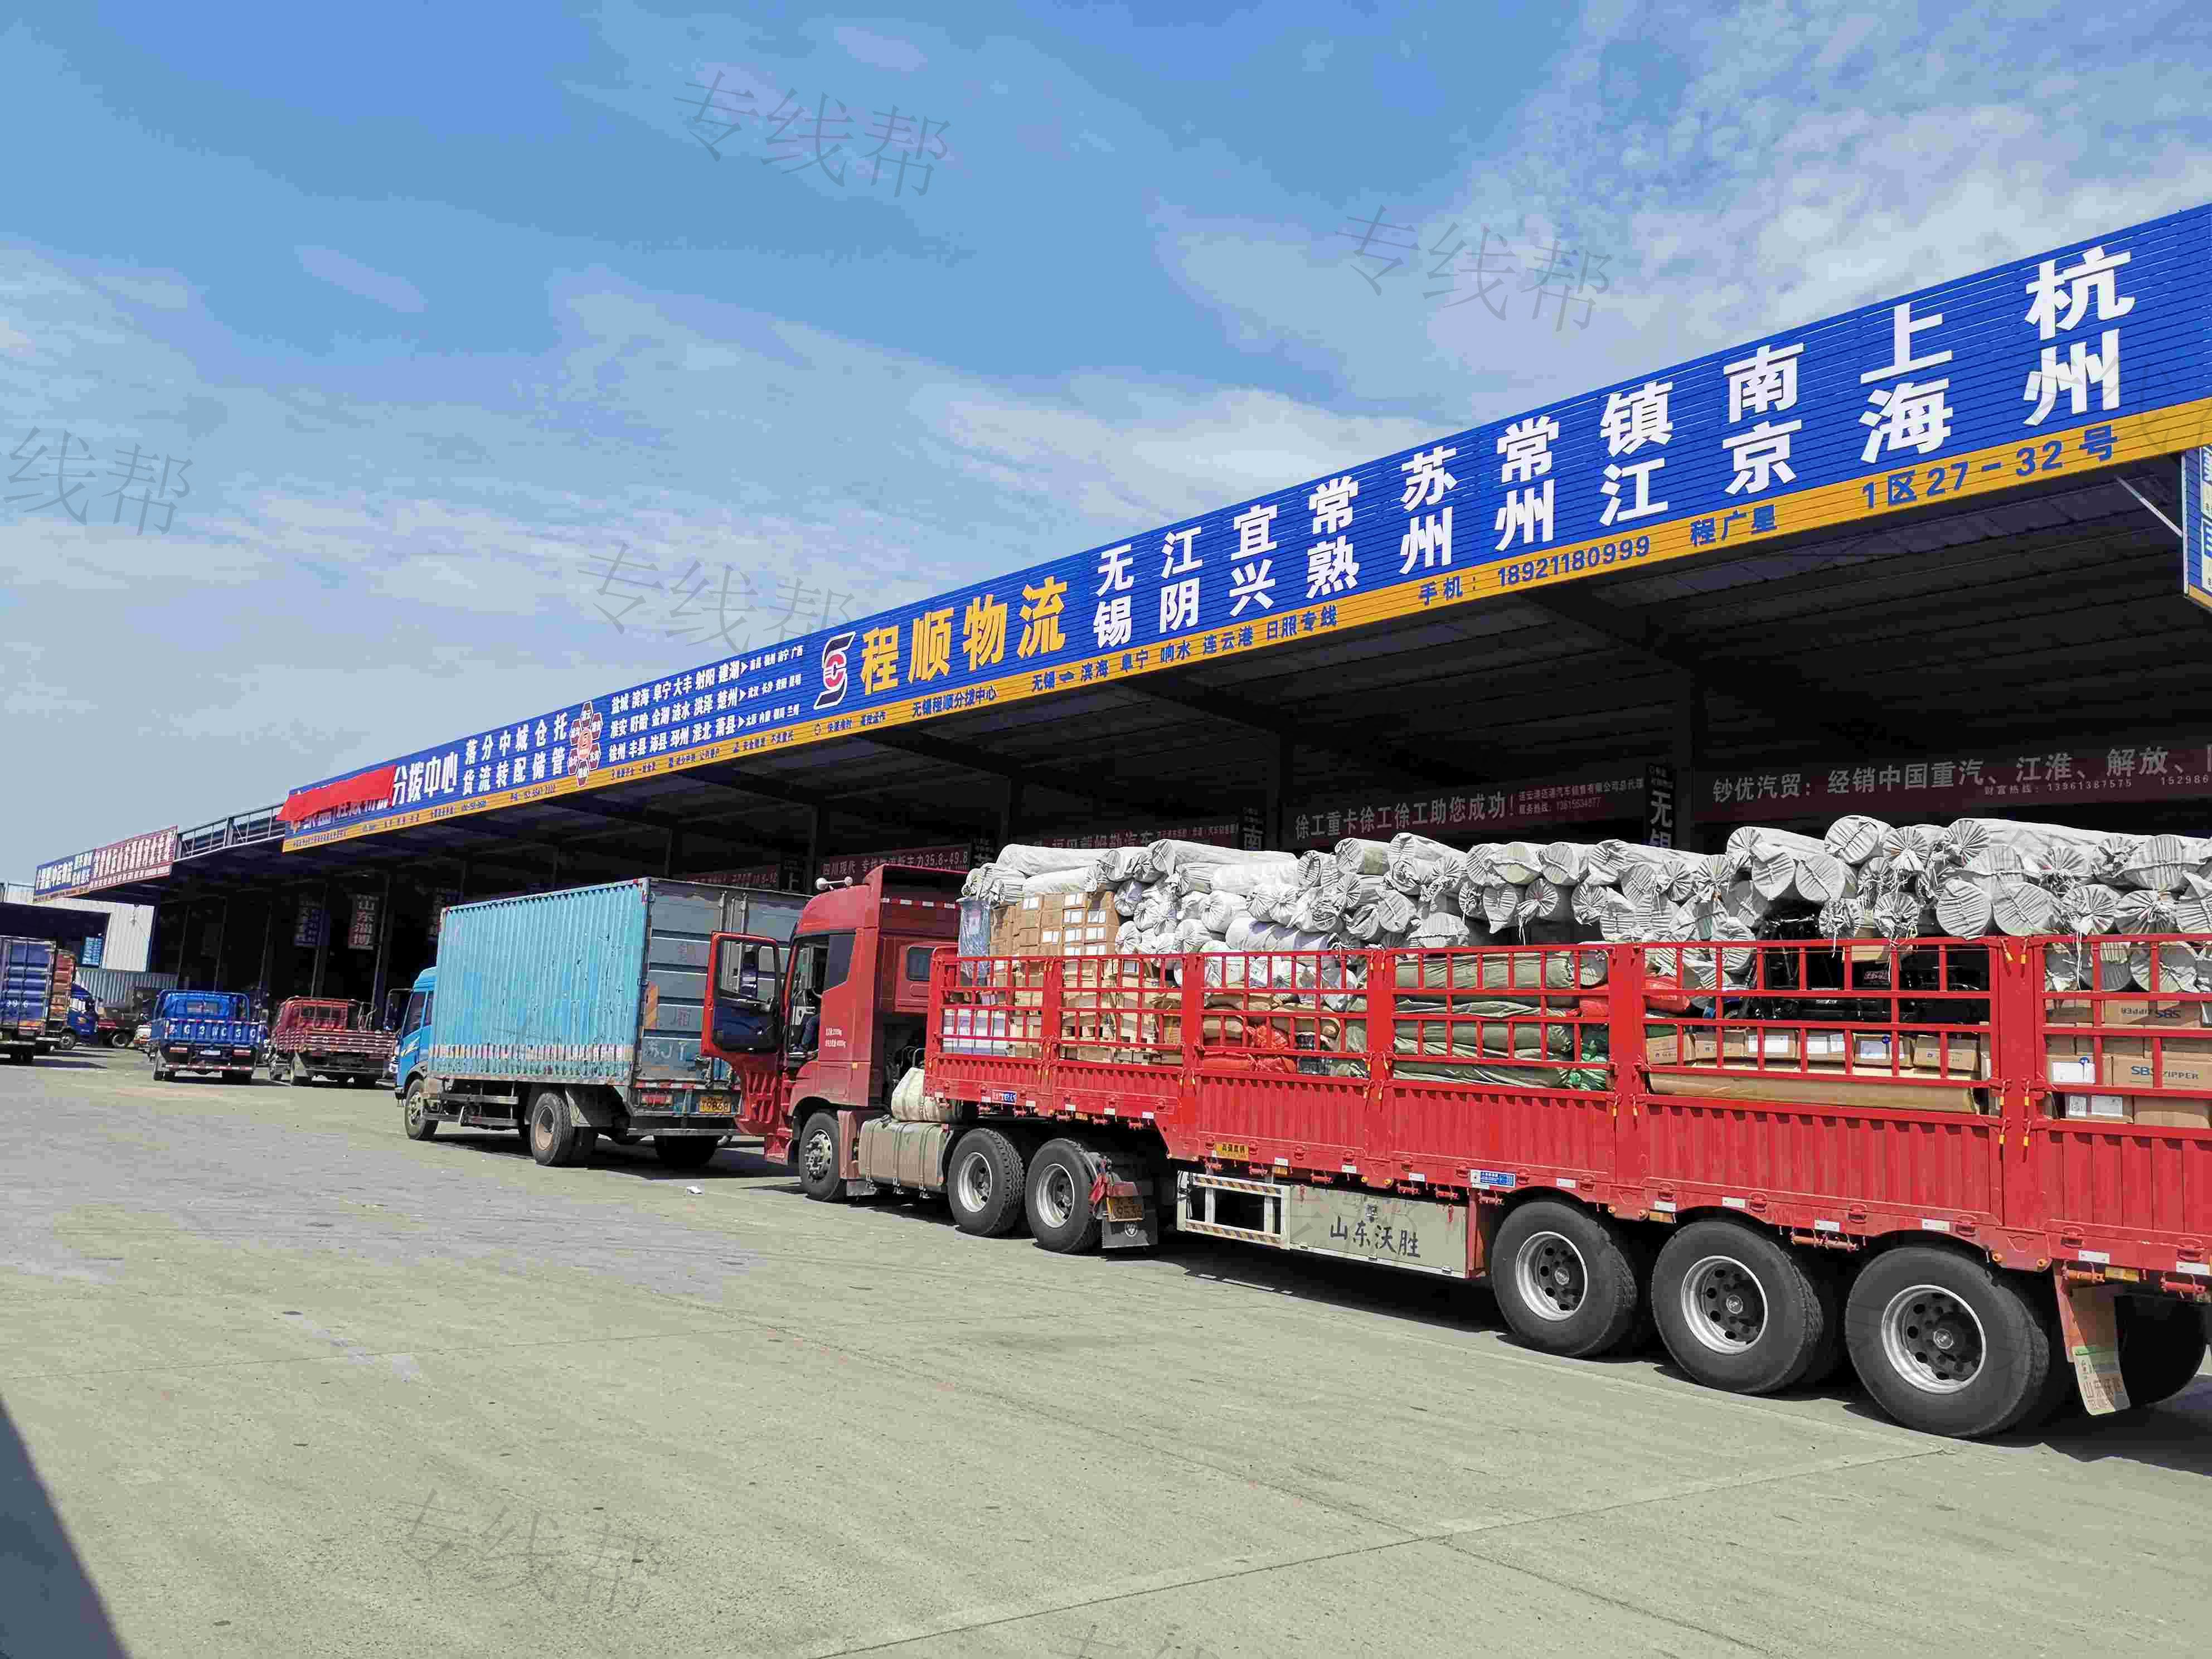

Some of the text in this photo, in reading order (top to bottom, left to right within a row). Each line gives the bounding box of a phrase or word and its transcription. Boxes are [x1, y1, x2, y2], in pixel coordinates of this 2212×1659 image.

[1860, 302, 1953, 463] 上海
[2022, 245, 2135, 426] 杭州
[1599, 381, 1673, 526] 镇江
[1722, 342, 1804, 495] 南京
[1306, 476, 1360, 599] 常熟
[1399, 445, 1457, 574] 苏州
[1494, 416, 1560, 551] 常州
[1093, 544, 1134, 648] 无锡
[1160, 526, 1203, 633] 江阴
[1229, 505, 1278, 617] 宜兴
[1498, 535, 1651, 588] 18921180999
[653, 680, 671, 702] 阜宁
[673, 675, 692, 697] 大丰
[695, 668, 715, 691] 射阳
[860, 575, 1068, 697] 程顺物流
[1032, 671, 1056, 692] 无锡
[1120, 649, 1149, 673] 阜宁
[1160, 639, 1191, 663] 响水
[1202, 626, 1254, 656] 连云港
[1265, 604, 1338, 641] 日照专线
[391, 751, 458, 807] 分拨中心
[609, 741, 626, 763] 徐州
[628, 738, 647, 759] 丰县
[670, 726, 689, 748] 邳州
[692, 721, 711, 744] 淮北
[1330, 1215, 1422, 1258] 山东沃胜
